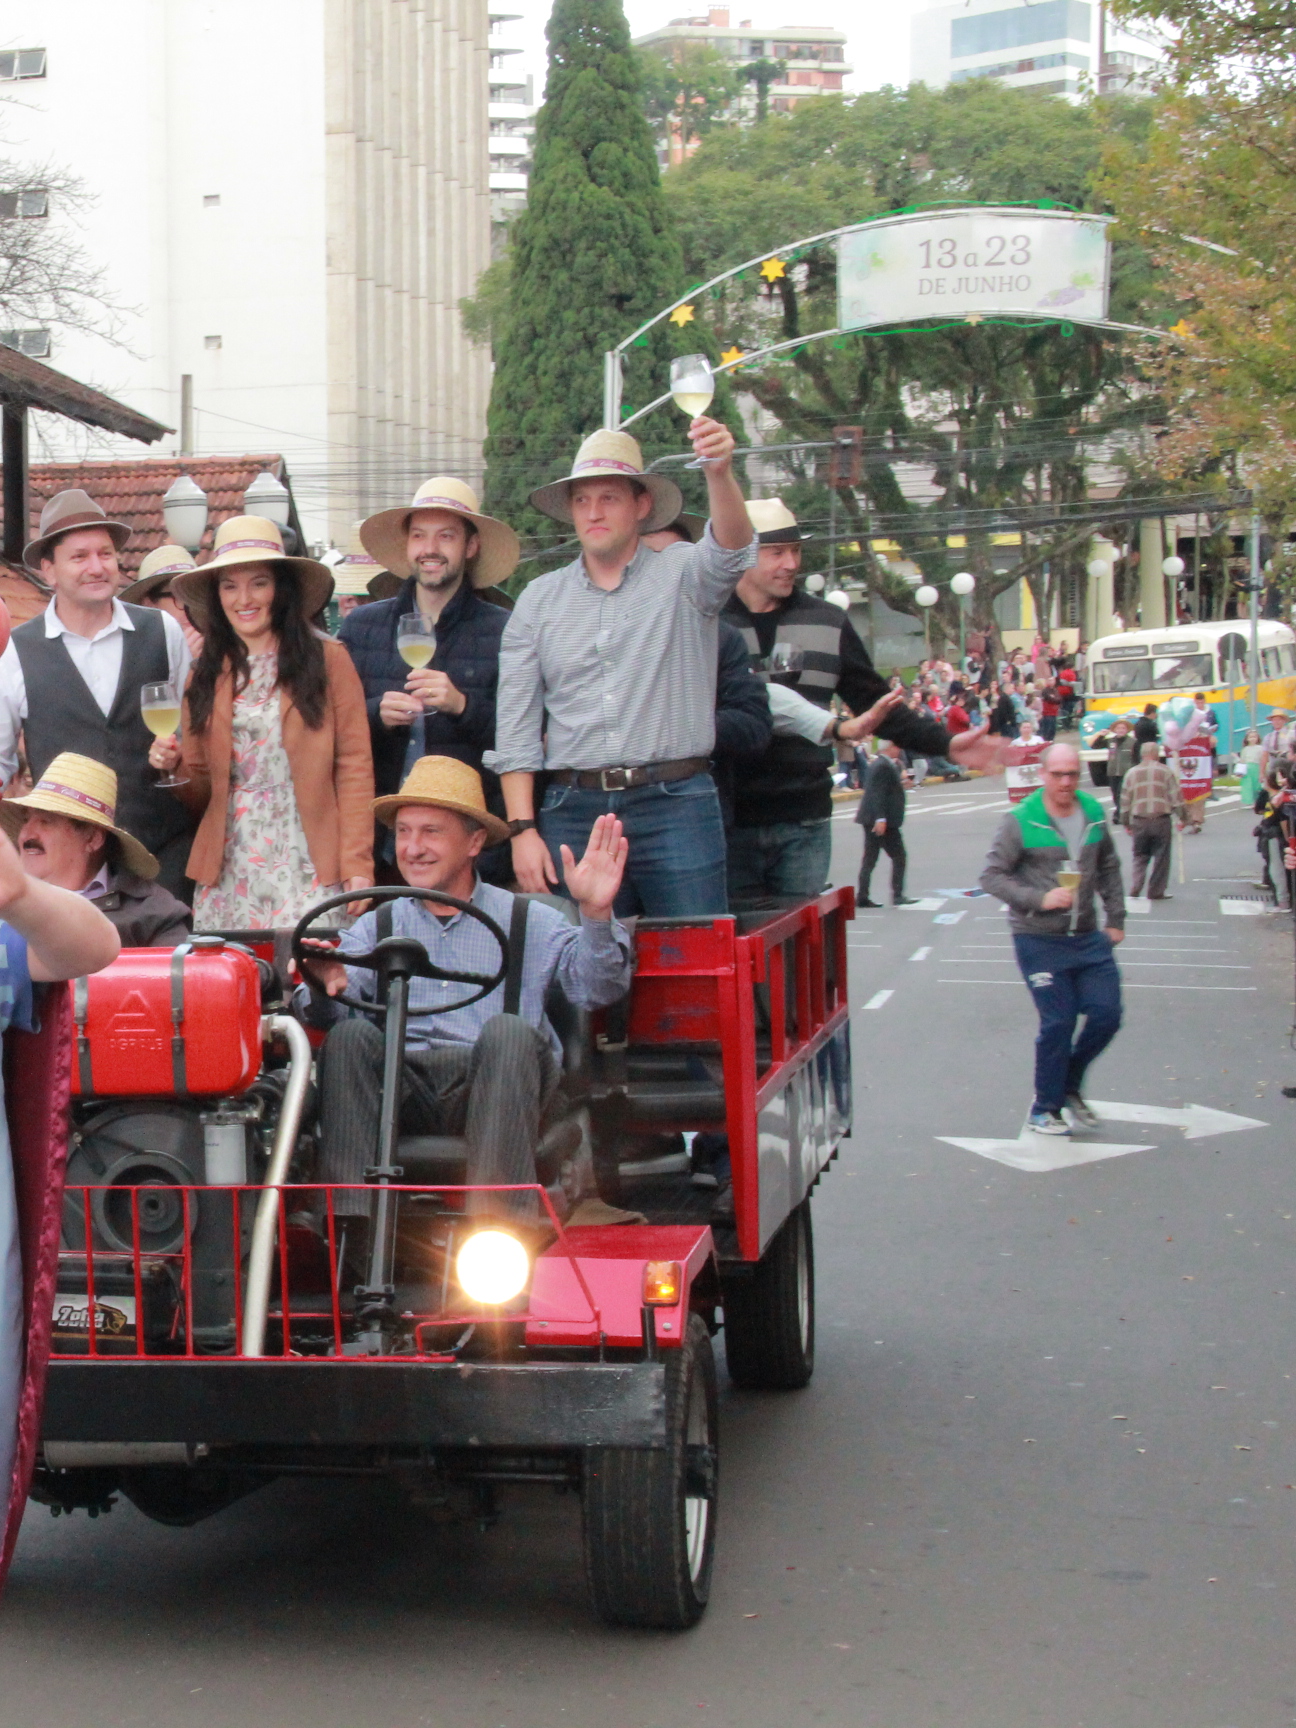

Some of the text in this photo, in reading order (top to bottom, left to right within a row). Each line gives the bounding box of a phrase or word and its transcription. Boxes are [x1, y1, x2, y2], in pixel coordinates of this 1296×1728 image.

[918, 234, 1032, 270] 13 a 23
[918, 274, 1032, 296] DE JUNHO
